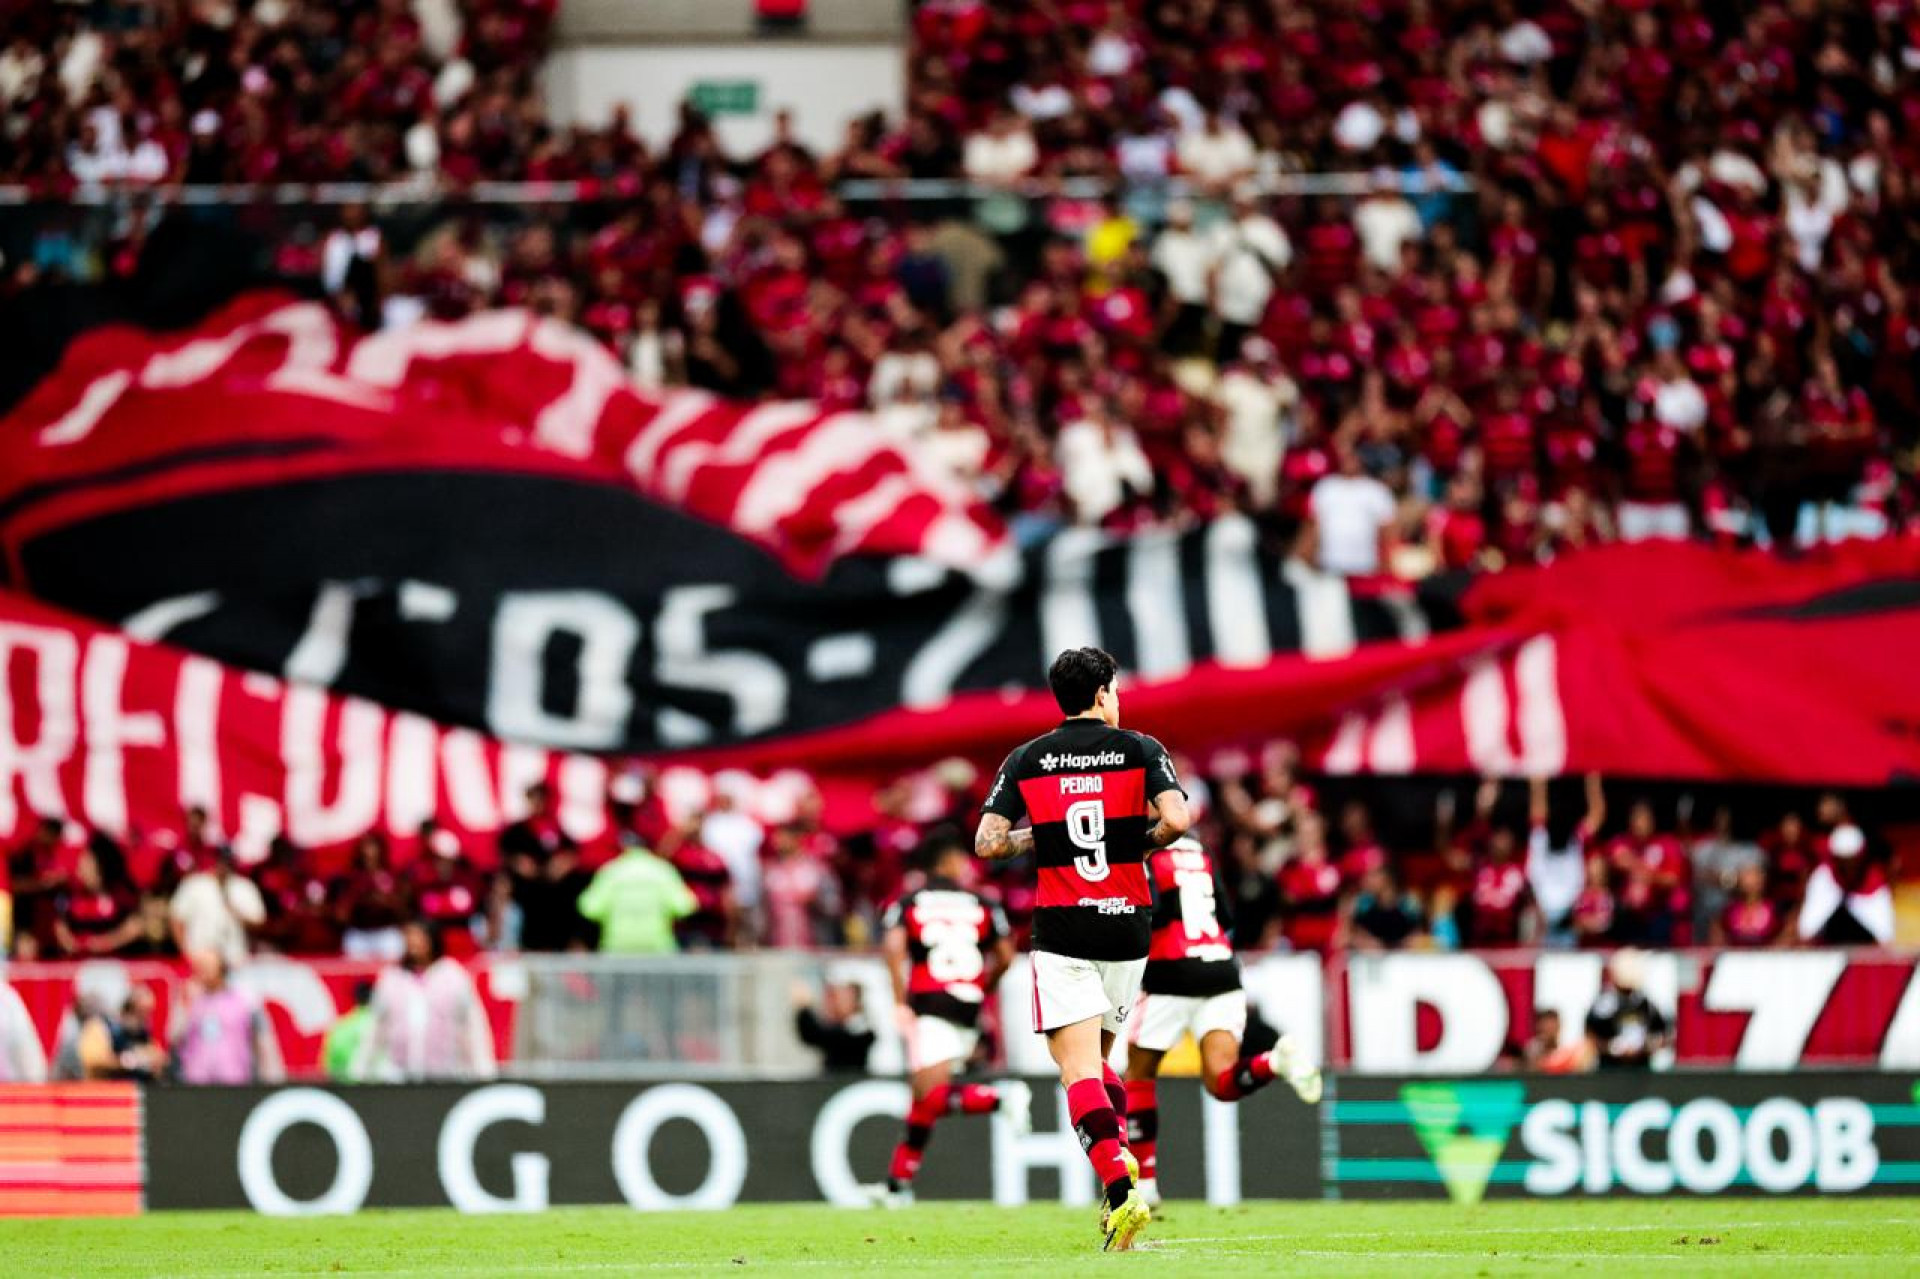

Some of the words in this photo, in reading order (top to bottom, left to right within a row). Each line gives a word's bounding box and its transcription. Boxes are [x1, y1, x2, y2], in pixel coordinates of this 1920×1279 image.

[1060, 751, 1125, 770] Hapvida
[1060, 775, 1104, 795] PEDRO
[1066, 800, 1111, 882] 9
[238, 1083, 1241, 1215] OGOCHI
[1520, 1097, 1880, 1195] SICOOB
